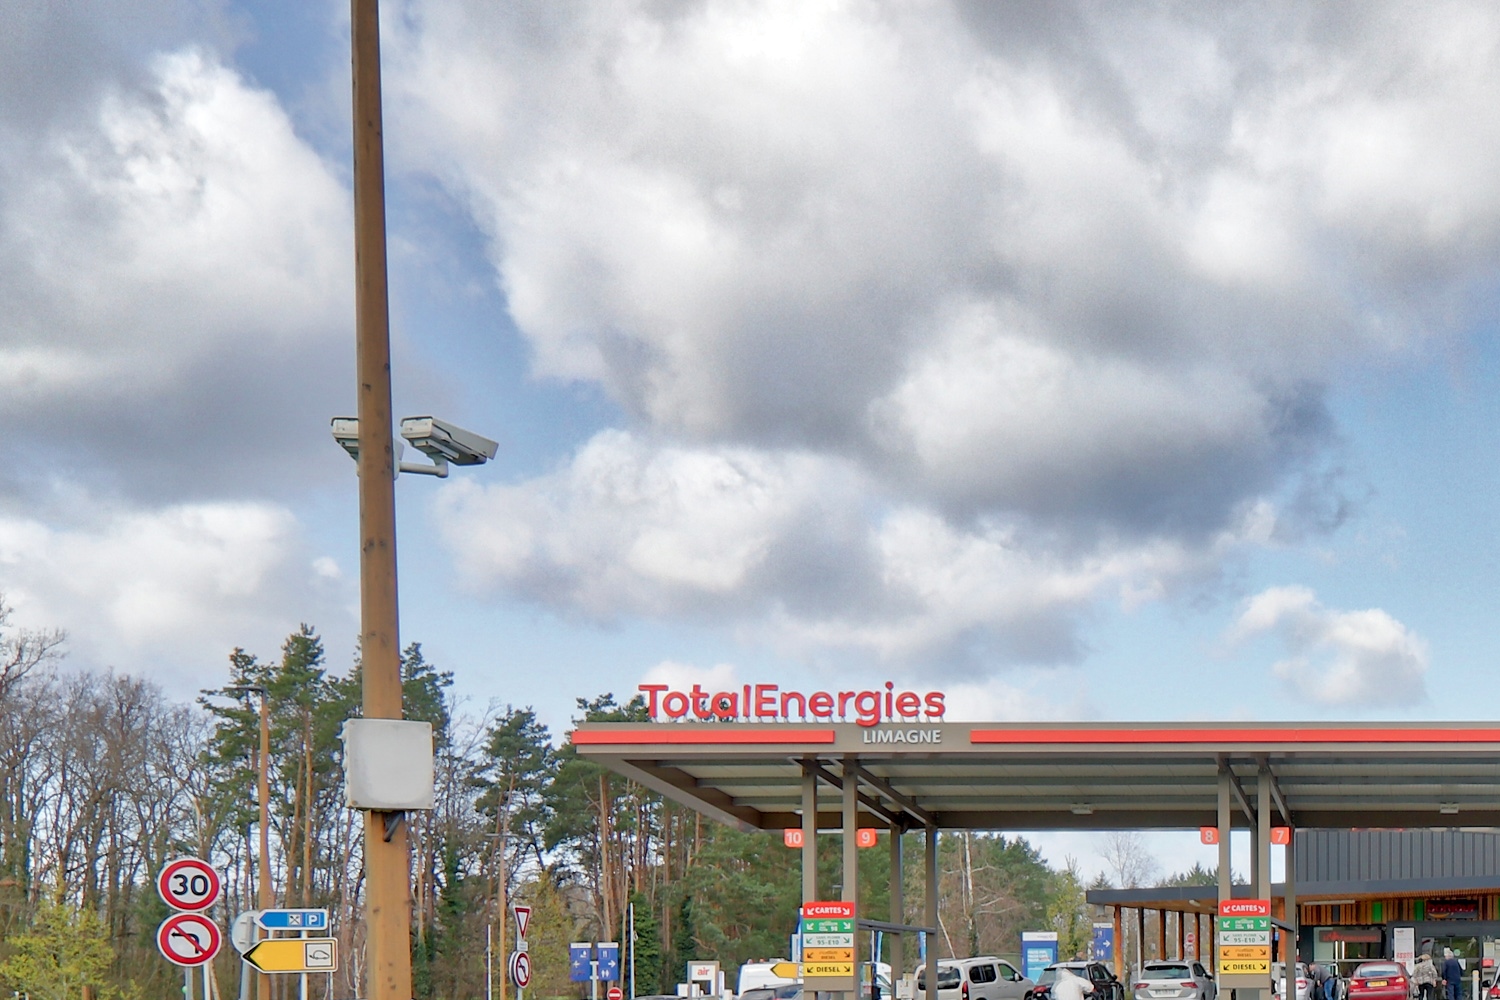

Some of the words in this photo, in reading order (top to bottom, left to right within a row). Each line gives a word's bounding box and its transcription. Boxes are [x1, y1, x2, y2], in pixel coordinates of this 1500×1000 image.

[638, 681, 946, 728] TotalEnergies
[863, 729, 942, 744] LIMAGNE
[788, 832, 802, 843] 10
[861, 832, 871, 843] 9
[1205, 830, 1213, 840] 8
[1277, 830, 1284, 840] 7
[172, 874, 209, 896] 30
[308, 915, 317, 923] P
[697, 967, 710, 975] air
